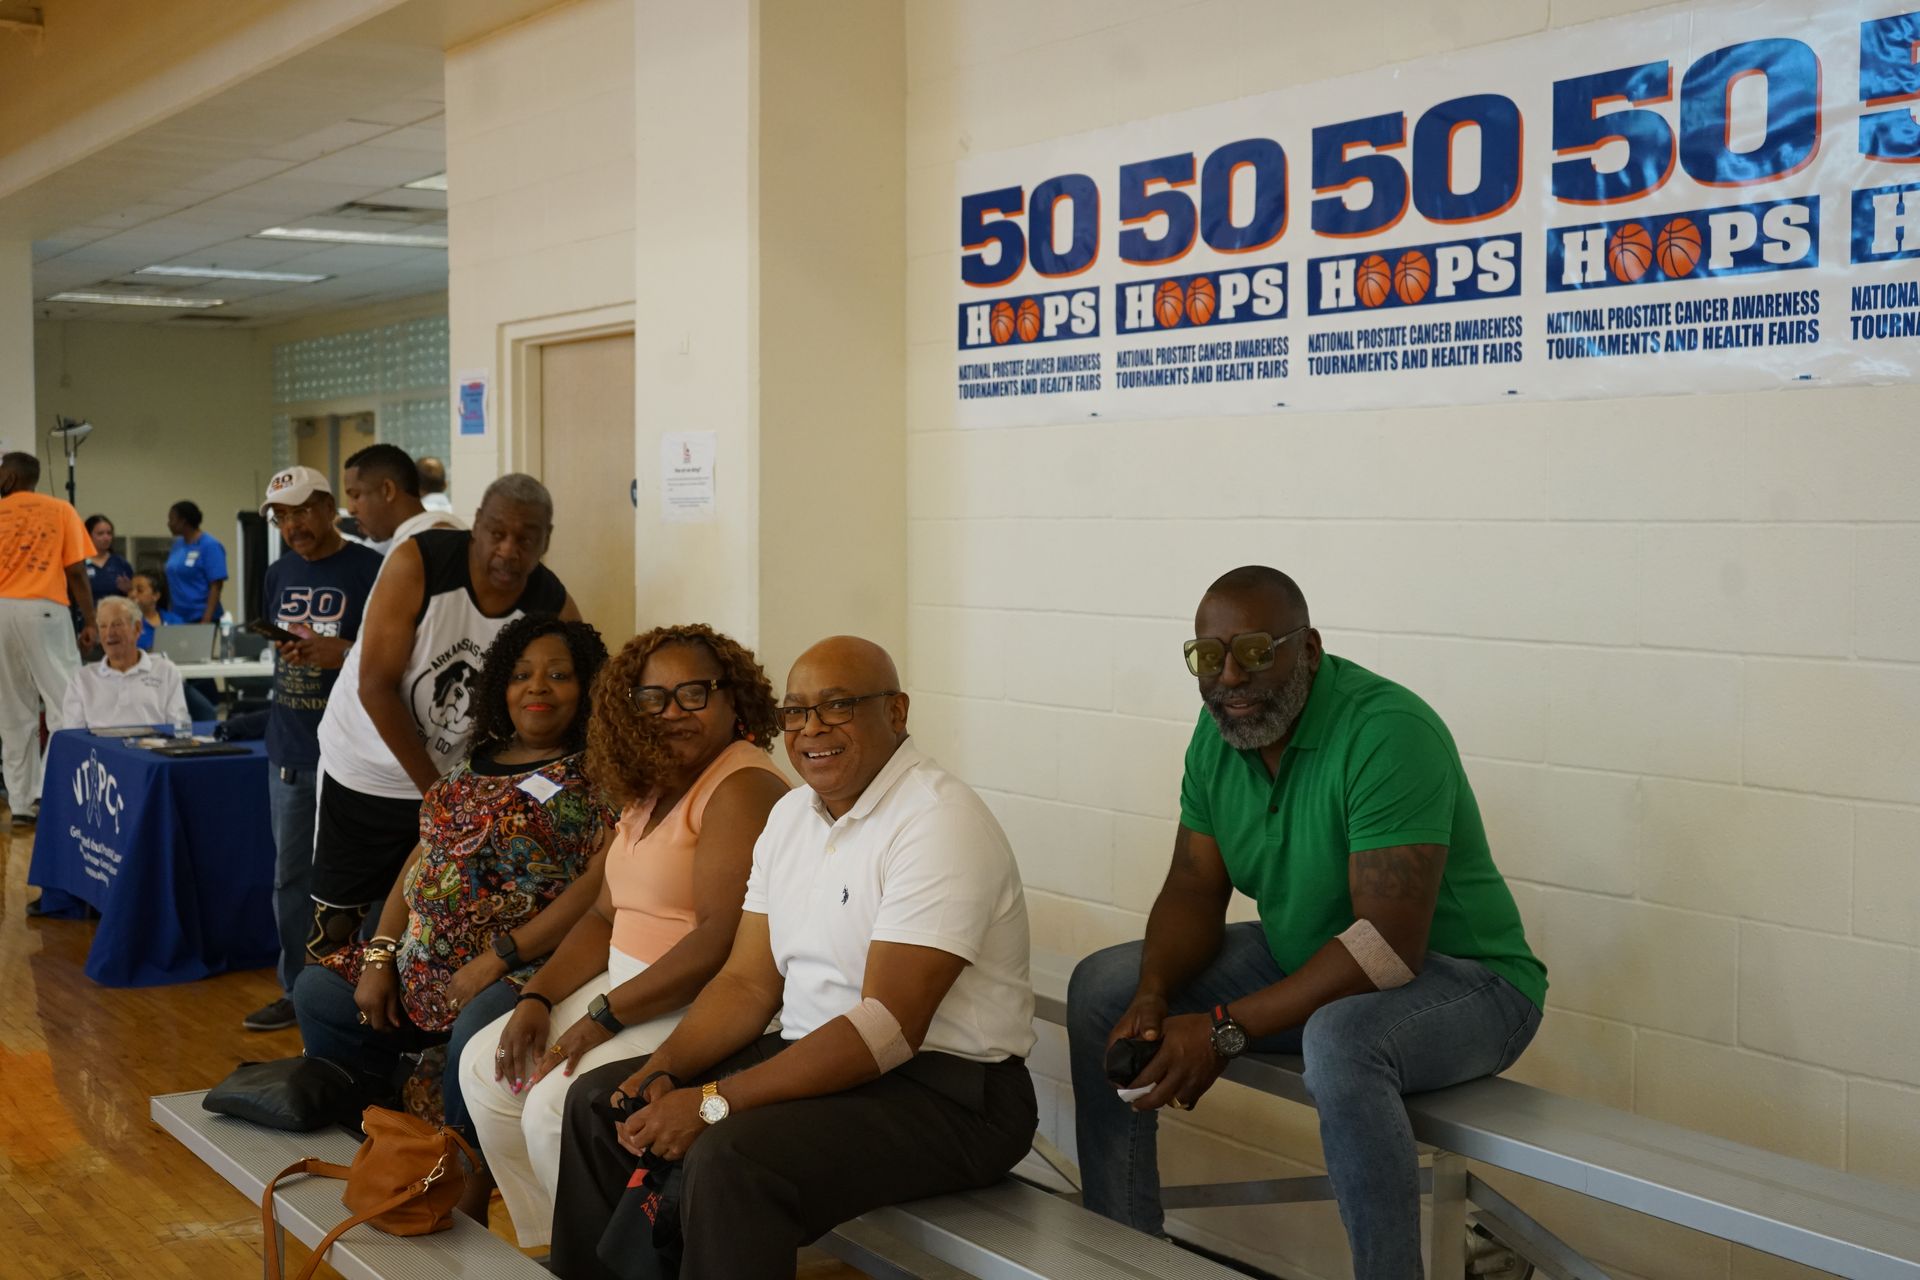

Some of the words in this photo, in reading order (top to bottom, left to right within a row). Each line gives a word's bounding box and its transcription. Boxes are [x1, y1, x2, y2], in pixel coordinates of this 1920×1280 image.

[1552, 38, 1822, 206] 50
[1311, 94, 1524, 238] 50
[1119, 138, 1289, 266] 50
[961, 174, 1100, 288] 50
[1562, 204, 1811, 285] HOOPS
[1320, 240, 1515, 309] HOOPS
[1851, 281, 1920, 311] NATIONA
[966, 291, 1097, 345] HOOPS
[1125, 268, 1284, 329] HOOPS
[1547, 309, 1605, 335] NATIONAL
[1608, 303, 1671, 330] PROSTATE
[1675, 298, 1728, 325] CANCER
[1732, 290, 1819, 321] AWARENESS
[1116, 350, 1153, 368] NATIONAL
[1156, 345, 1196, 365] PROSTATE
[1198, 341, 1232, 362] CANCER
[1234, 336, 1289, 359] AWARENESS
[1308, 332, 1354, 353] NATIONAL
[1357, 326, 1407, 349] PROSTATE
[1409, 322, 1450, 345] CANCER
[1454, 315, 1523, 341] AWARENESS
[1547, 331, 1660, 360] TOURNAMENTS
[1664, 328, 1698, 353] AND
[1702, 323, 1763, 350] HEALTH
[1768, 319, 1820, 346] FAIRS
[959, 363, 991, 380] NATIONAL
[993, 360, 1024, 378] PROSTATE
[1025, 357, 1054, 375] CANCER
[1056, 353, 1101, 373] AWARENESS
[1116, 366, 1189, 389] TOURNAMENTS
[1192, 365, 1213, 384] AND
[1216, 362, 1253, 382] HEALTH
[1257, 359, 1288, 380] FAIRS
[1308, 350, 1398, 375] TOURNAMENTS
[1402, 349, 1427, 369] AND
[1432, 345, 1479, 367] HEALTH
[1483, 341, 1523, 364] FAIRS
[959, 380, 1018, 400] TOURNAMENTS
[1021, 378, 1037, 395] AND
[1039, 376, 1073, 393] HEALTH
[1075, 374, 1101, 391] FAIRS
[277, 586, 346, 622] 50
